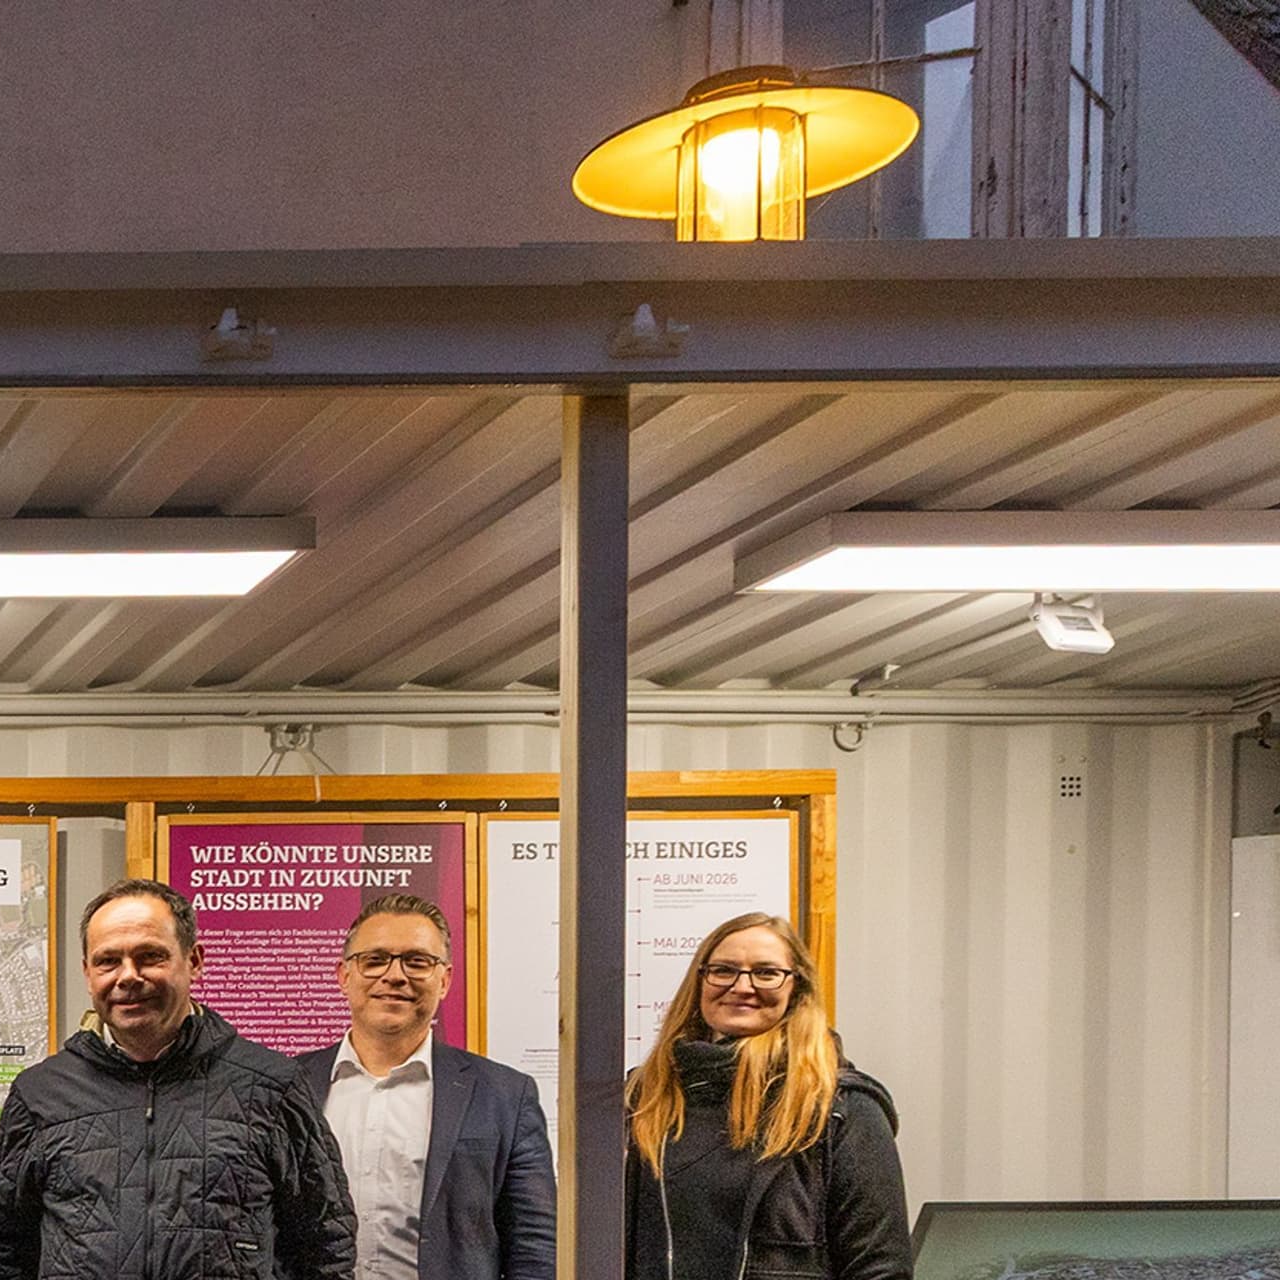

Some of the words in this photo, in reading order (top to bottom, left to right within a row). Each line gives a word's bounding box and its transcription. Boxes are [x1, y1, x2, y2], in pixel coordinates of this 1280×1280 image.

[190, 846, 236, 863] WIE
[241, 842, 337, 863] KÖNNTE
[342, 846, 432, 863] UNSERE
[512, 843, 538, 860] ES
[656, 841, 747, 859] EINIGES
[190, 869, 265, 887] STADT
[270, 870, 295, 886] IN
[300, 869, 412, 887] ZUKUNFT
[654, 874, 671, 885] AB
[673, 874, 704, 885] JUNI
[706, 873, 738, 885] 2026
[192, 893, 324, 911] AUSSEHEN?
[654, 938, 677, 949] MAI
